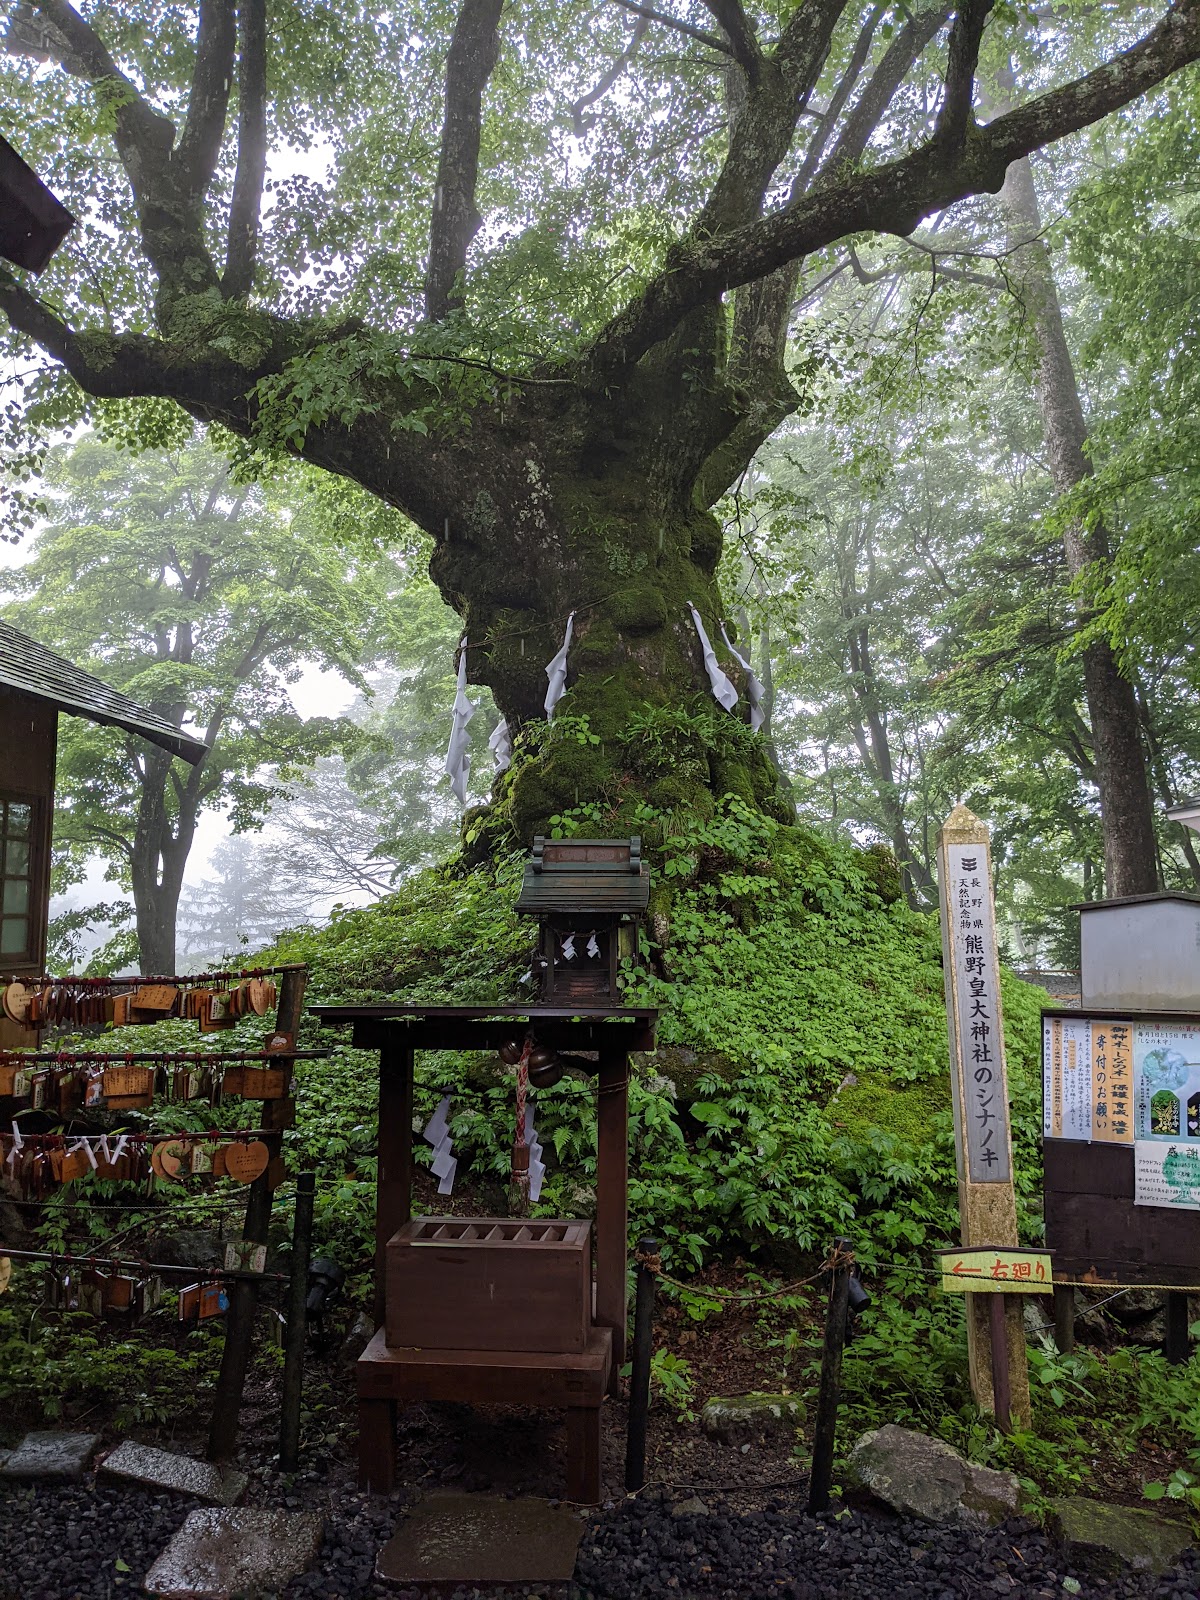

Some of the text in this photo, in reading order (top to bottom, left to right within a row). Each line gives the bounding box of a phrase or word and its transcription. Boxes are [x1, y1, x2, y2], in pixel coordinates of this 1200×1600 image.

[958, 878, 971, 929] 天然記念物
[970, 878, 984, 929] 長野県
[964, 934, 999, 1168] 熊野皇大神社のシナノキ
[1110, 1026, 1130, 1080] 御神木「しなの木」
[1095, 1035, 1108, 1129] 寄付のお願い
[1110, 1083, 1129, 1099] 保護
[1111, 1102, 1129, 1117] 育成
[1167, 1144, 1199, 1161] 感謝
[989, 1259, 1045, 1281] 右廻り
